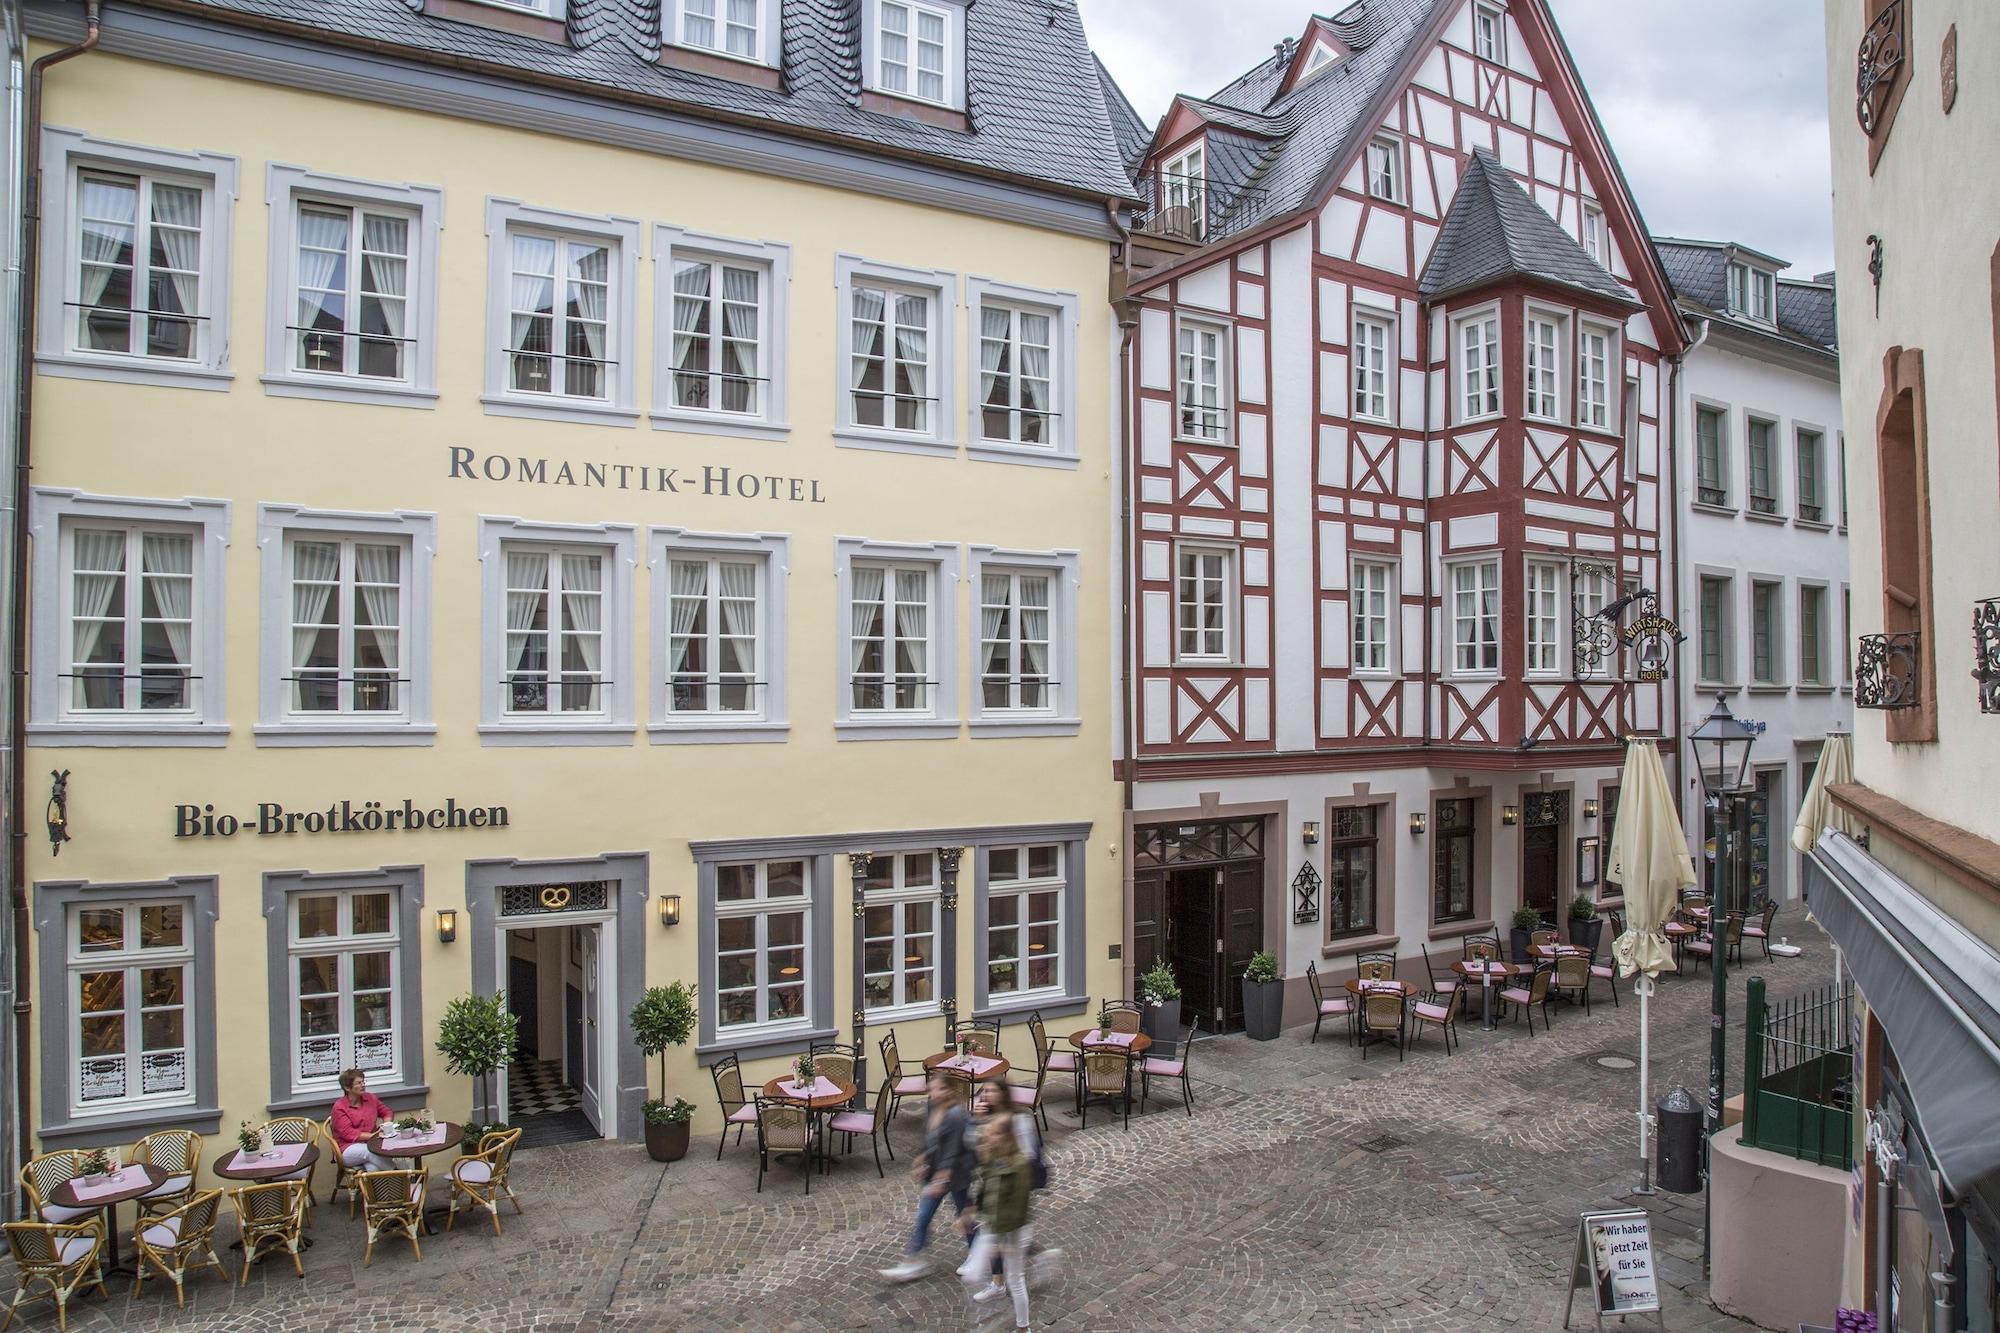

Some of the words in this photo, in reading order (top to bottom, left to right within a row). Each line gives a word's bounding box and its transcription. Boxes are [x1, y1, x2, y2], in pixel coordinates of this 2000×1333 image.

[1625, 616, 1679, 639] WIRTSHAUS
[1646, 627, 1658, 636] ZUR
[1640, 670, 1665, 680] HOTEL
[174, 798, 511, 837] Bio-Brotkörbchen
[1606, 1225, 1620, 1236] Wir
[1622, 1224, 1647, 1235] haben
[1610, 1243, 1630, 1255] jetzt
[1632, 1241, 1649, 1252] Zeit
[1618, 1259, 1631, 1270] für
[1632, 1259, 1646, 1269] Sie
